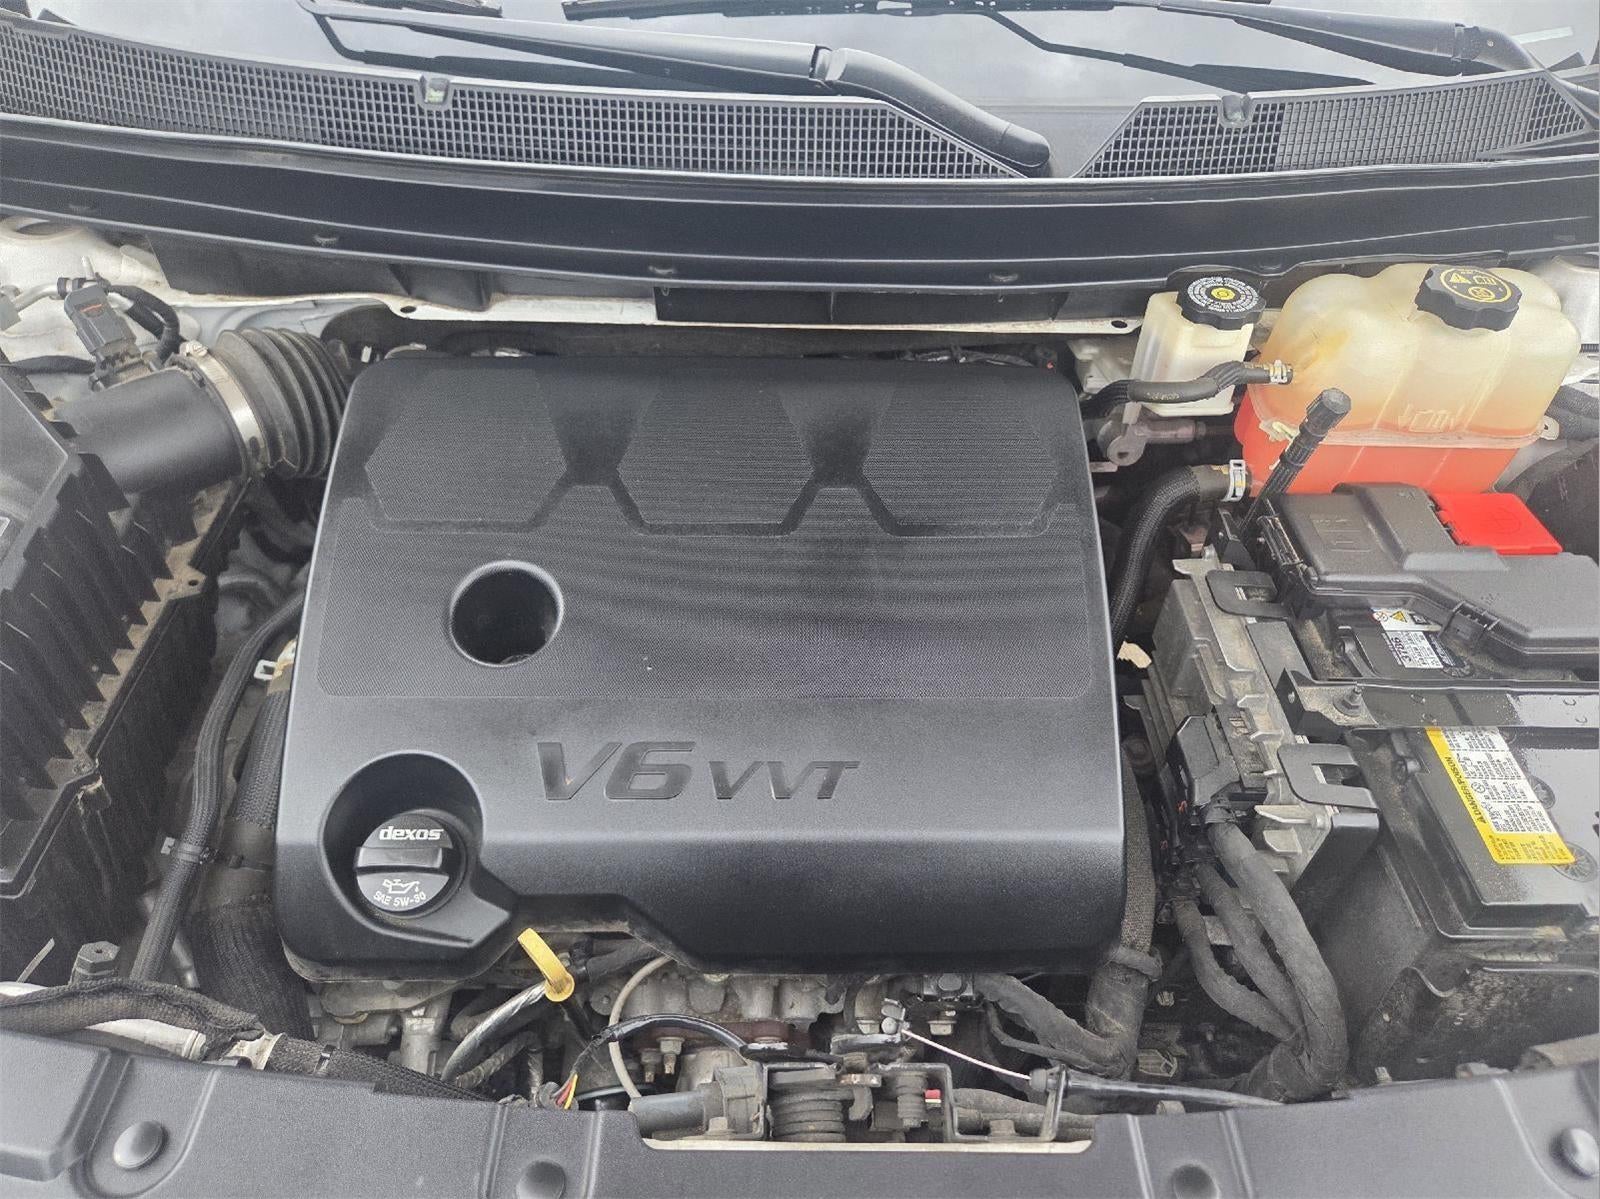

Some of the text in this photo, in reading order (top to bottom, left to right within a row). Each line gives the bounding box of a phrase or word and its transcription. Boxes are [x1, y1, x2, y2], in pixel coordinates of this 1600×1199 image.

[537, 742, 860, 800] V6 VVT
[379, 826, 444, 841] dexos
[373, 890, 427, 907] SAE 5W-30
